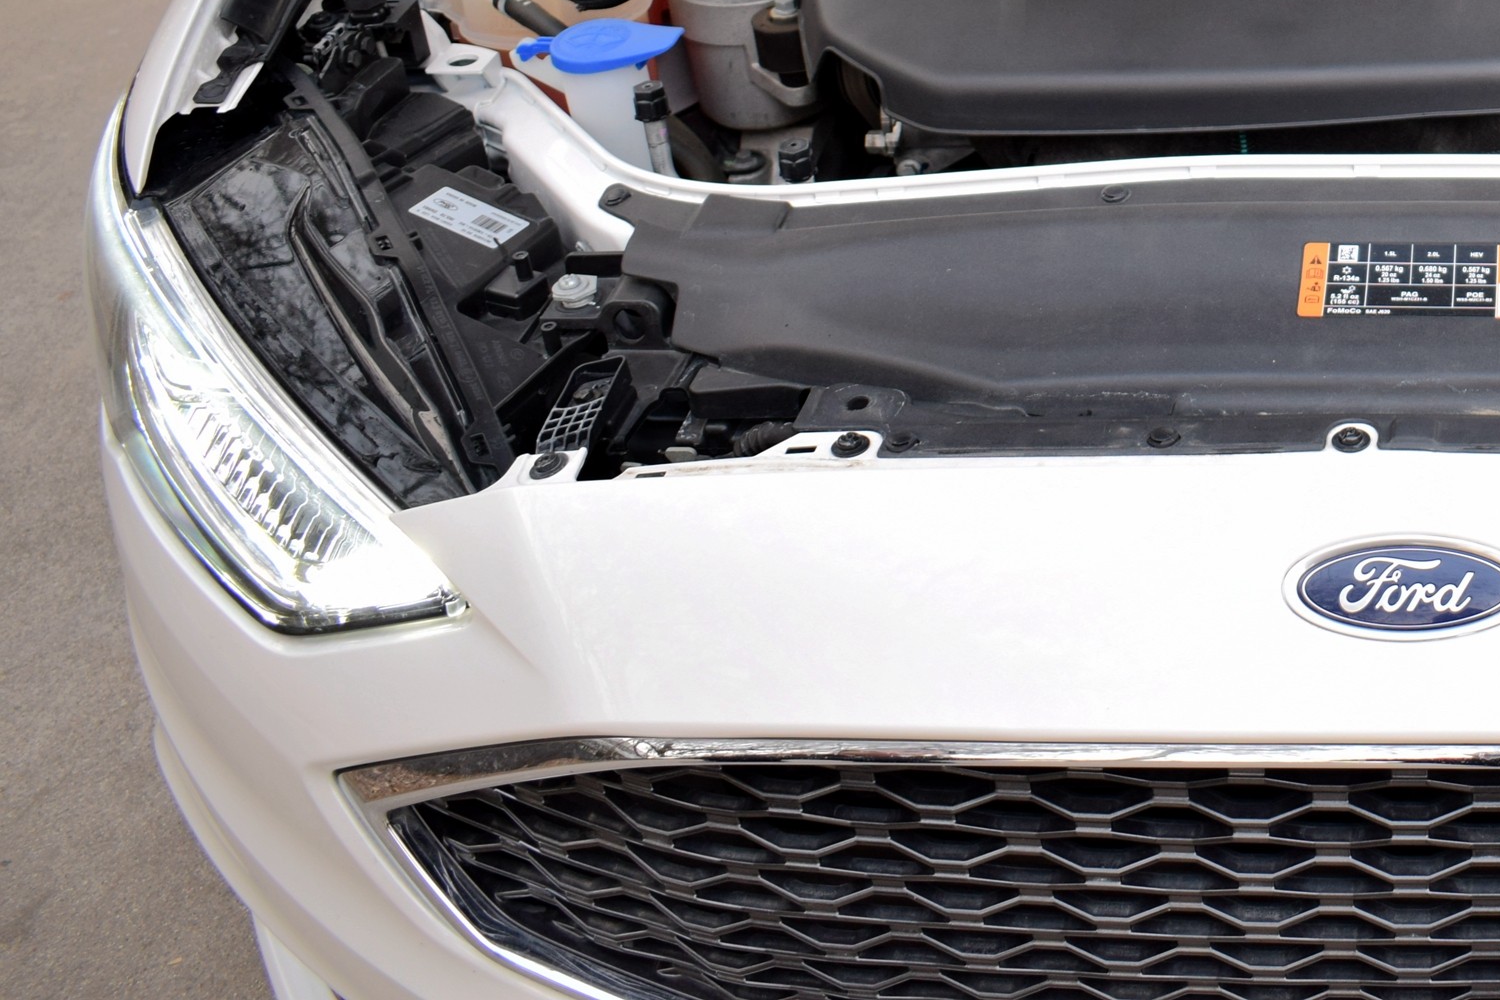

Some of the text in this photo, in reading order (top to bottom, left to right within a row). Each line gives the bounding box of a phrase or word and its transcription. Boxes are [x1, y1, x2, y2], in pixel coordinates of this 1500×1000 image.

[1394, 265, 1404, 273] kg
[1438, 266, 1448, 274] kg
[1481, 266, 1490, 274] kg
[1333, 274, 1360, 282] R-134a
[1338, 555, 1475, 614] Ford
